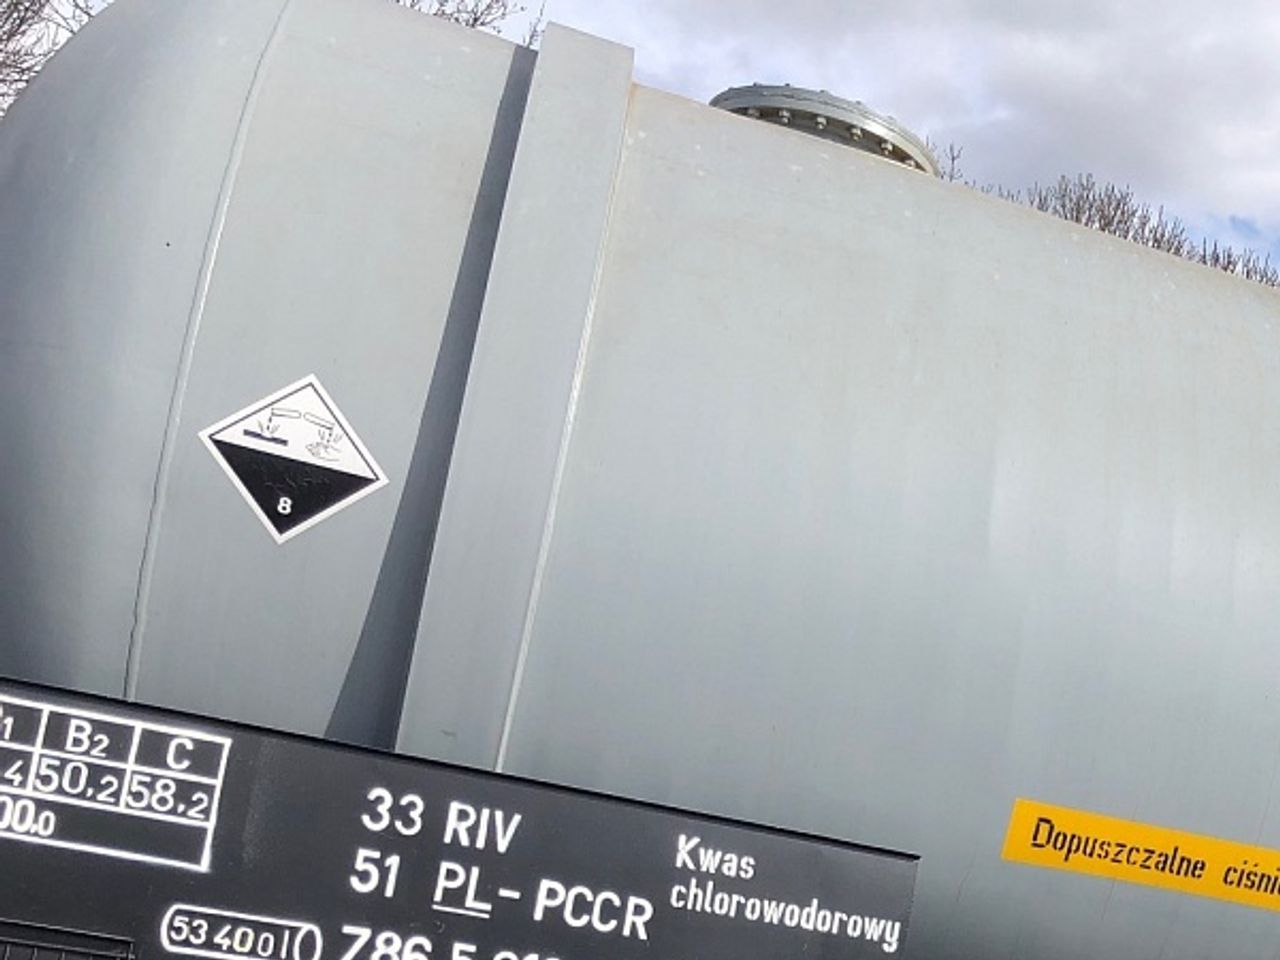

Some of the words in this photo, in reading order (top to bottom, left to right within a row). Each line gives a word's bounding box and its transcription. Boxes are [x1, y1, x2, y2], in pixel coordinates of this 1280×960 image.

[276, 496, 293, 515] 8
[65, 718, 110, 757] B2
[165, 736, 195, 771] C
[360, 786, 425, 836] 33
[443, 800, 522, 854] RIV
[1030, 816, 1207, 879] Dopuszczalne
[675, 833, 756, 881] Kwas
[349, 847, 401, 898] 51
[533, 878, 654, 941] PCCR
[669, 882, 901, 953] chlorowodorowy
